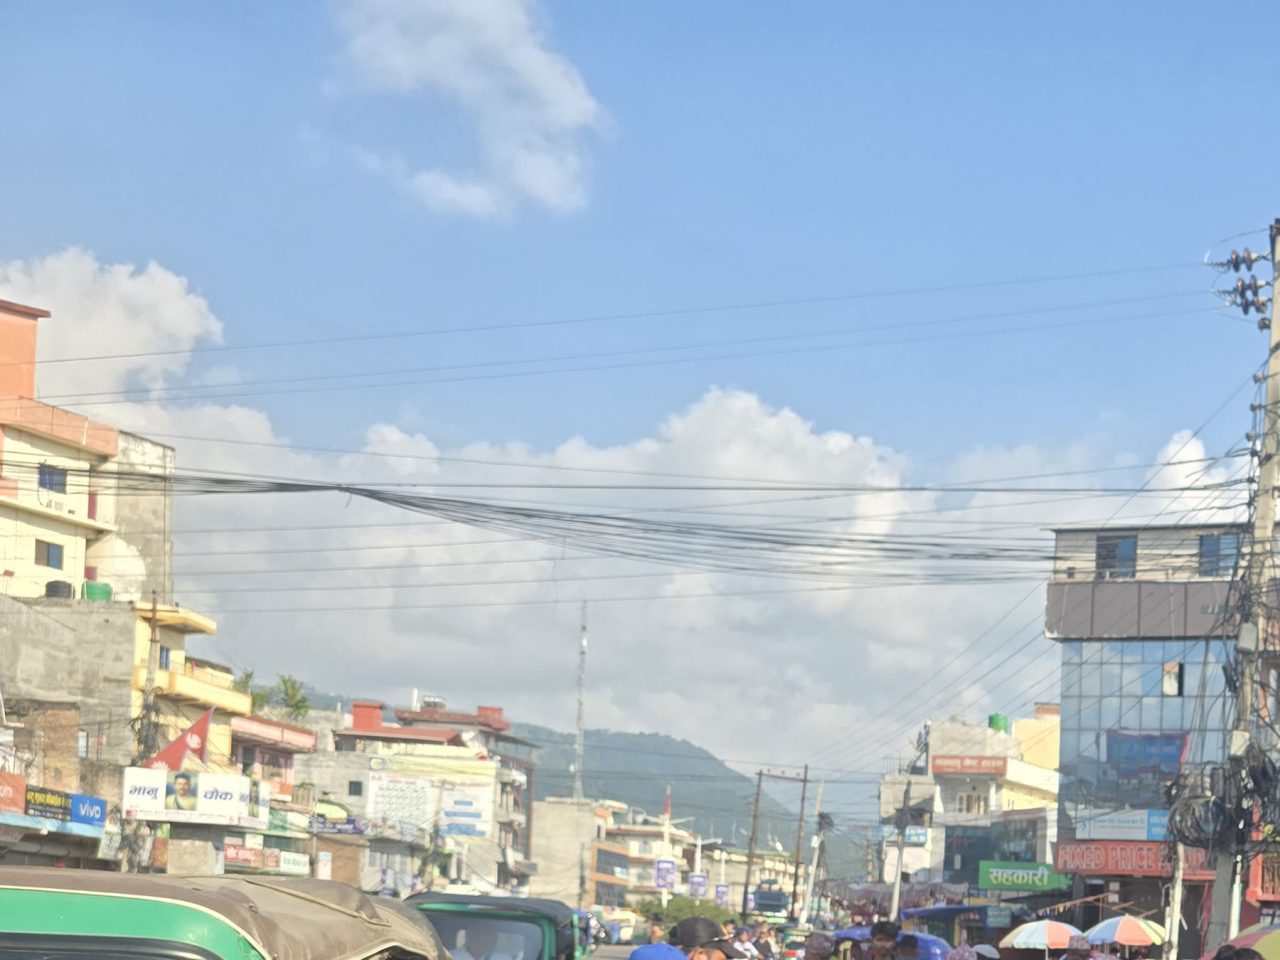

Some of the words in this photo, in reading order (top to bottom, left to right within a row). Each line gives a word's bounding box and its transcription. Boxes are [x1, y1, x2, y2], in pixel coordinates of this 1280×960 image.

[129, 785, 160, 800] भानु
[203, 786, 234, 801] चोक
[80, 799, 101, 819] vivo
[1057, 844, 1105, 869] FIXED
[1108, 845, 1154, 871] PRICE
[988, 866, 1049, 886] सहकारी
